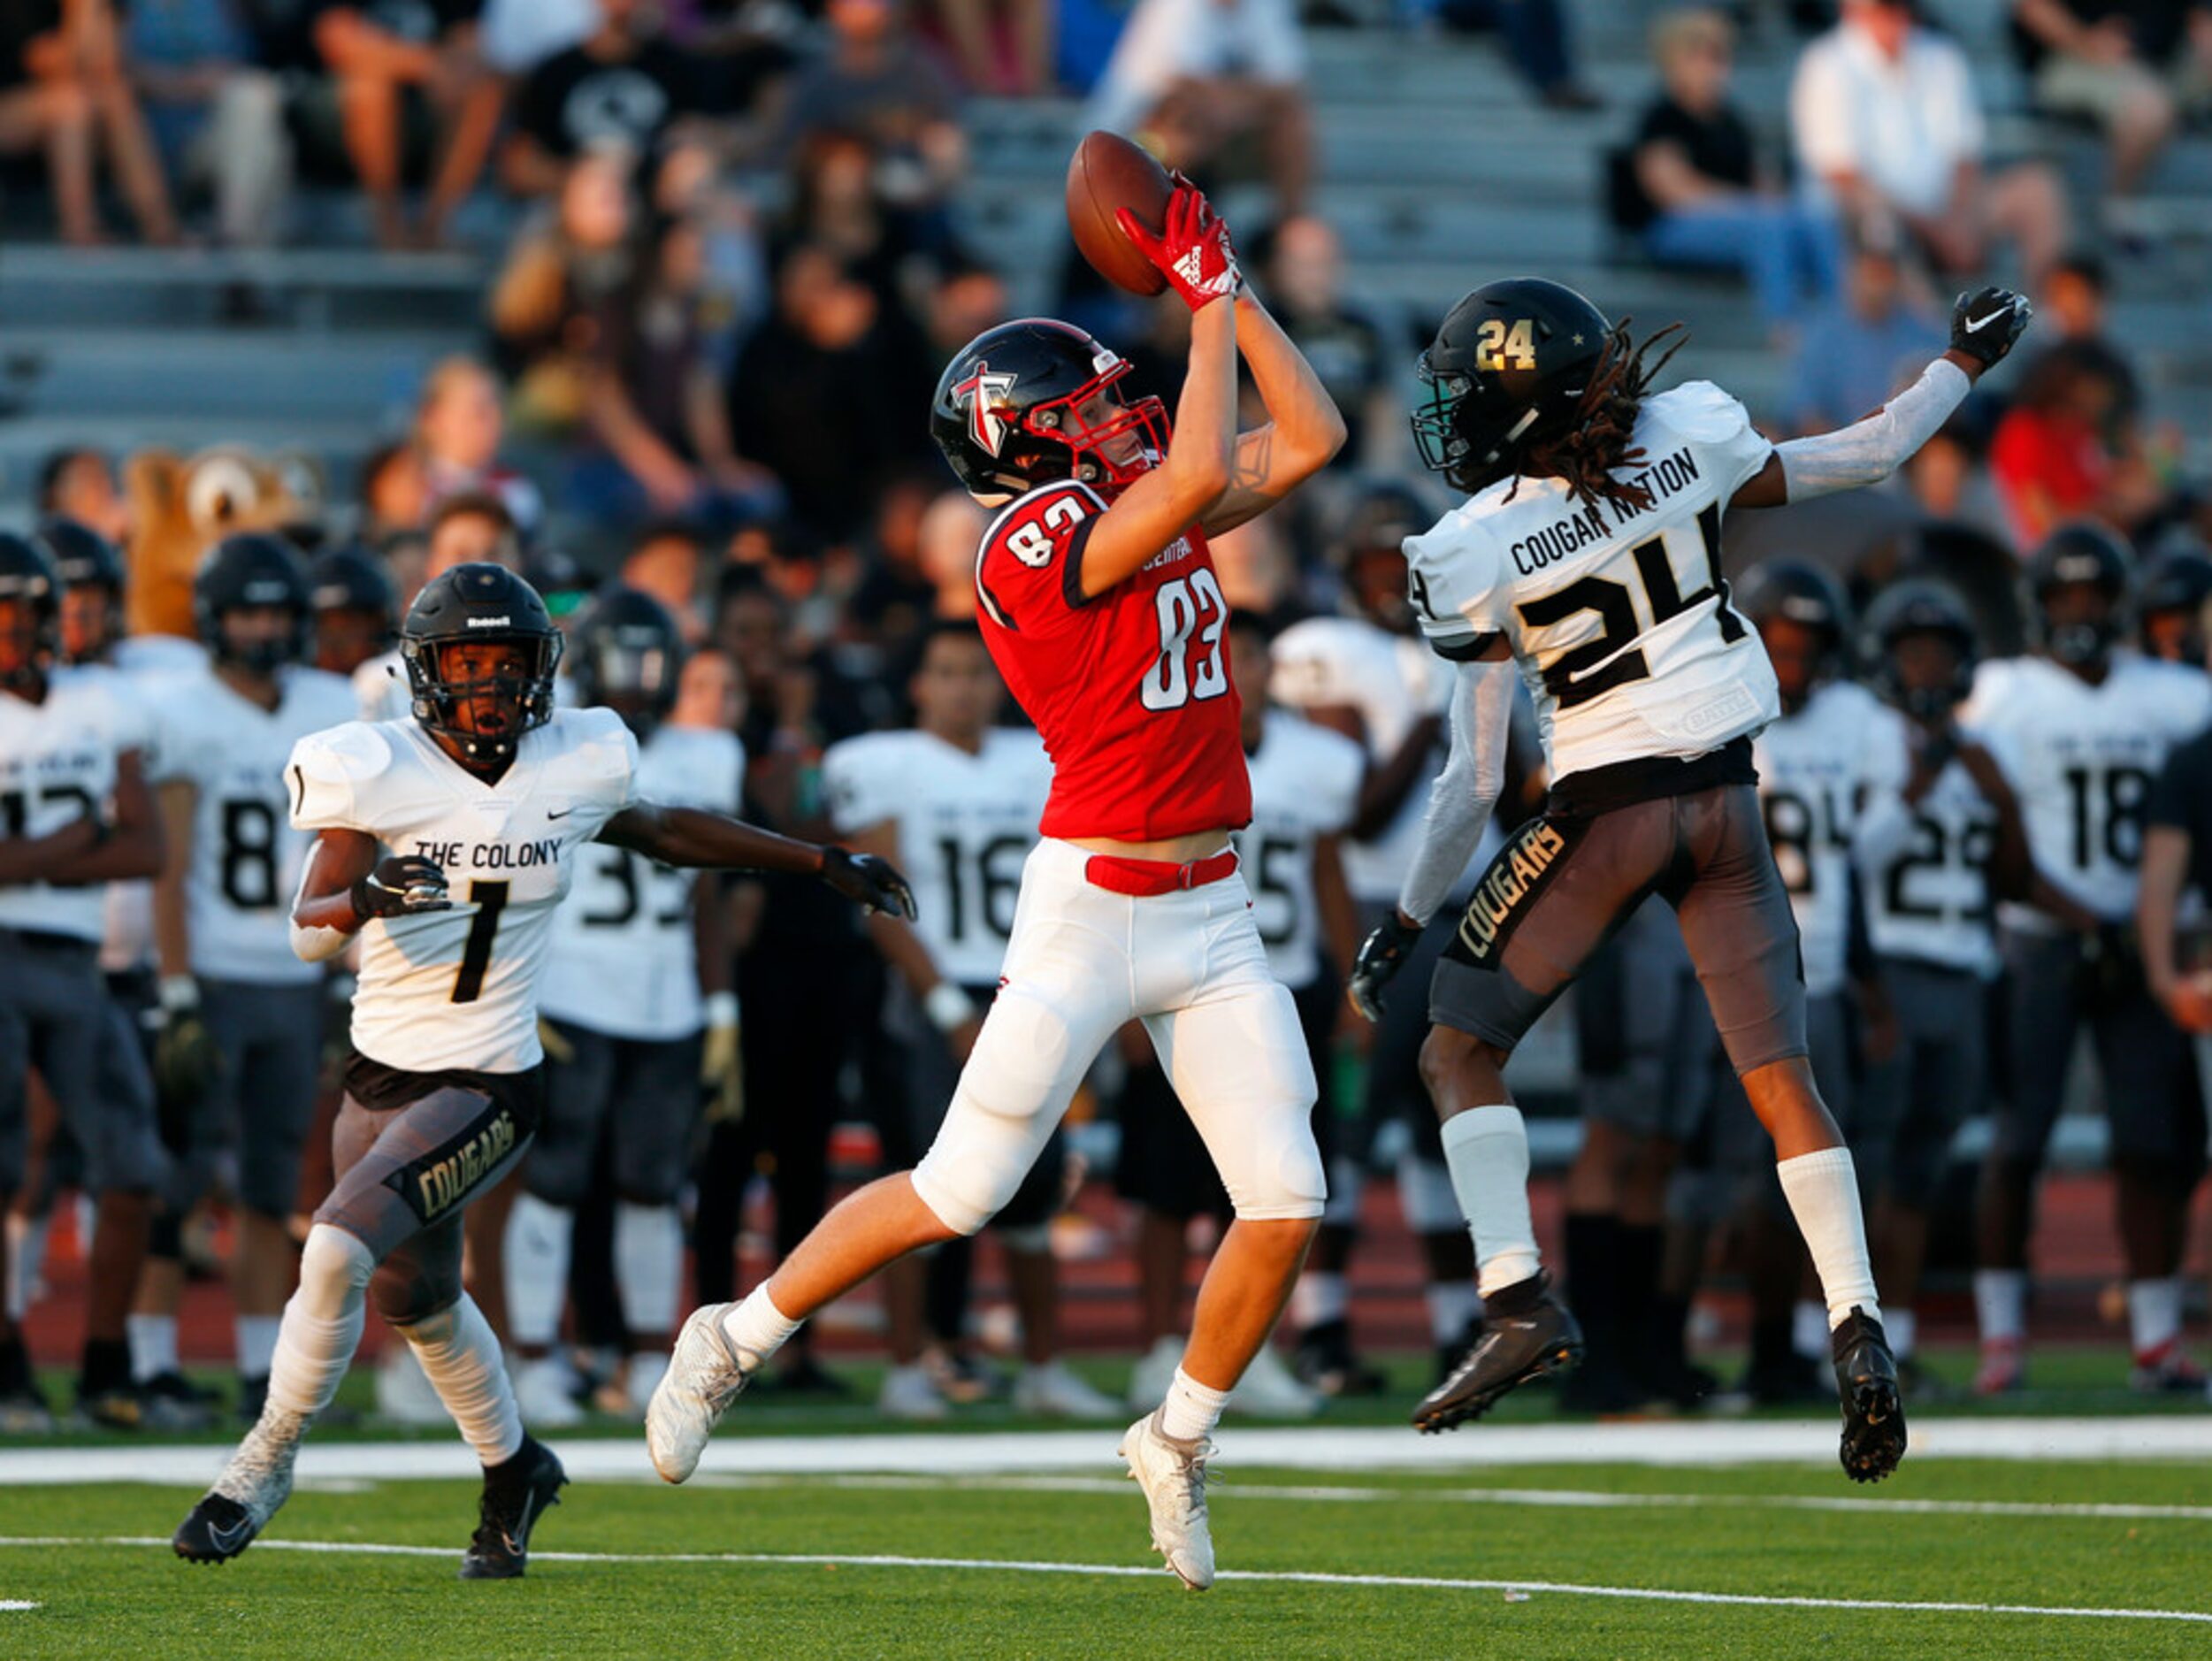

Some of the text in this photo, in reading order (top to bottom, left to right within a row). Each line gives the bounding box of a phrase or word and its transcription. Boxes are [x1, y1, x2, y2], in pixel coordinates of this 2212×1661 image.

[1475, 318, 1536, 371] 24
[1140, 567, 1228, 711] 83
[1513, 498, 1749, 711] 24
[416, 838, 563, 869] THE COLONY
[2064, 766, 2152, 873] 18
[449, 877, 512, 1004] 1
[938, 834, 1029, 942] 16
[1458, 819, 1565, 959] COUGARS
[418, 1109, 516, 1218] COUGARS
